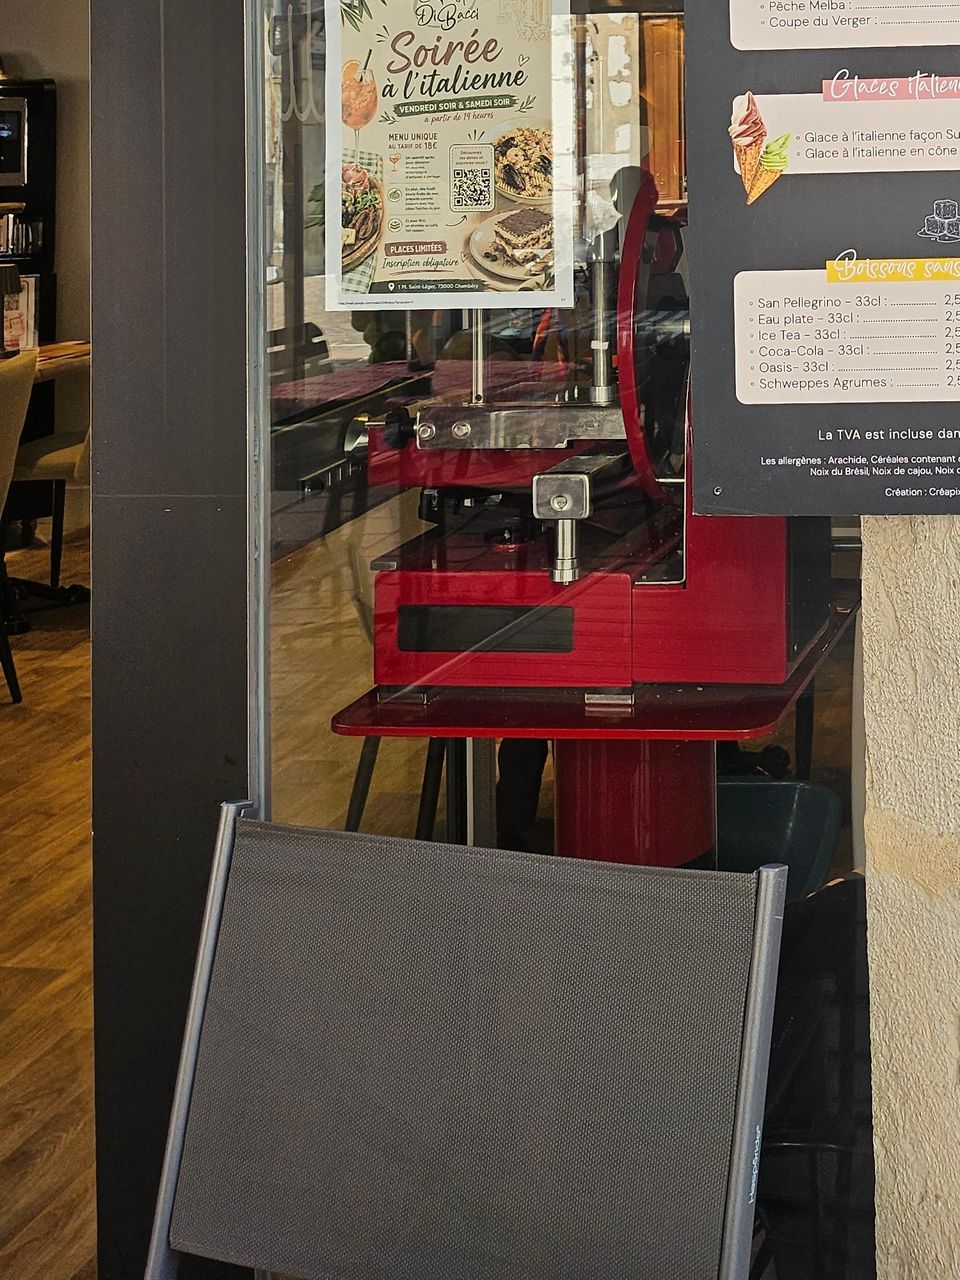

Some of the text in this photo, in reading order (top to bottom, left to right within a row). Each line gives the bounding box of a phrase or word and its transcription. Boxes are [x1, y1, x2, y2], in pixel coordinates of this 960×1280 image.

[386, 28, 504, 74] Soirée
[382, 78, 399, 98] à
[831, 69, 899, 99] Glaces
[399, 98, 510, 114] VENDREDI SOIR & SAMEDI SOIR
[431, 114, 452, 126] partir
[454, 113, 462, 122] de
[463, 112, 471, 120] 19
[472, 111, 494, 120] heures
[389, 132, 437, 141] MENU UNIQUE
[391, 243, 442, 254] PLACES LIMITÉES
[382, 257, 459, 271] Inscription obligatoire
[834, 249, 916, 280] Boissons
[758, 296, 780, 308] San
[784, 295, 841, 310] Pellegrino
[855, 295, 881, 307] 33cl
[818, 429, 833, 440] La
[837, 429, 861, 440] TVA
[865, 430, 884, 440] est
[889, 428, 933, 440] incluse
[761, 457, 868, 466] Les allergènes Arachide,
[885, 487, 923, 497] Création
